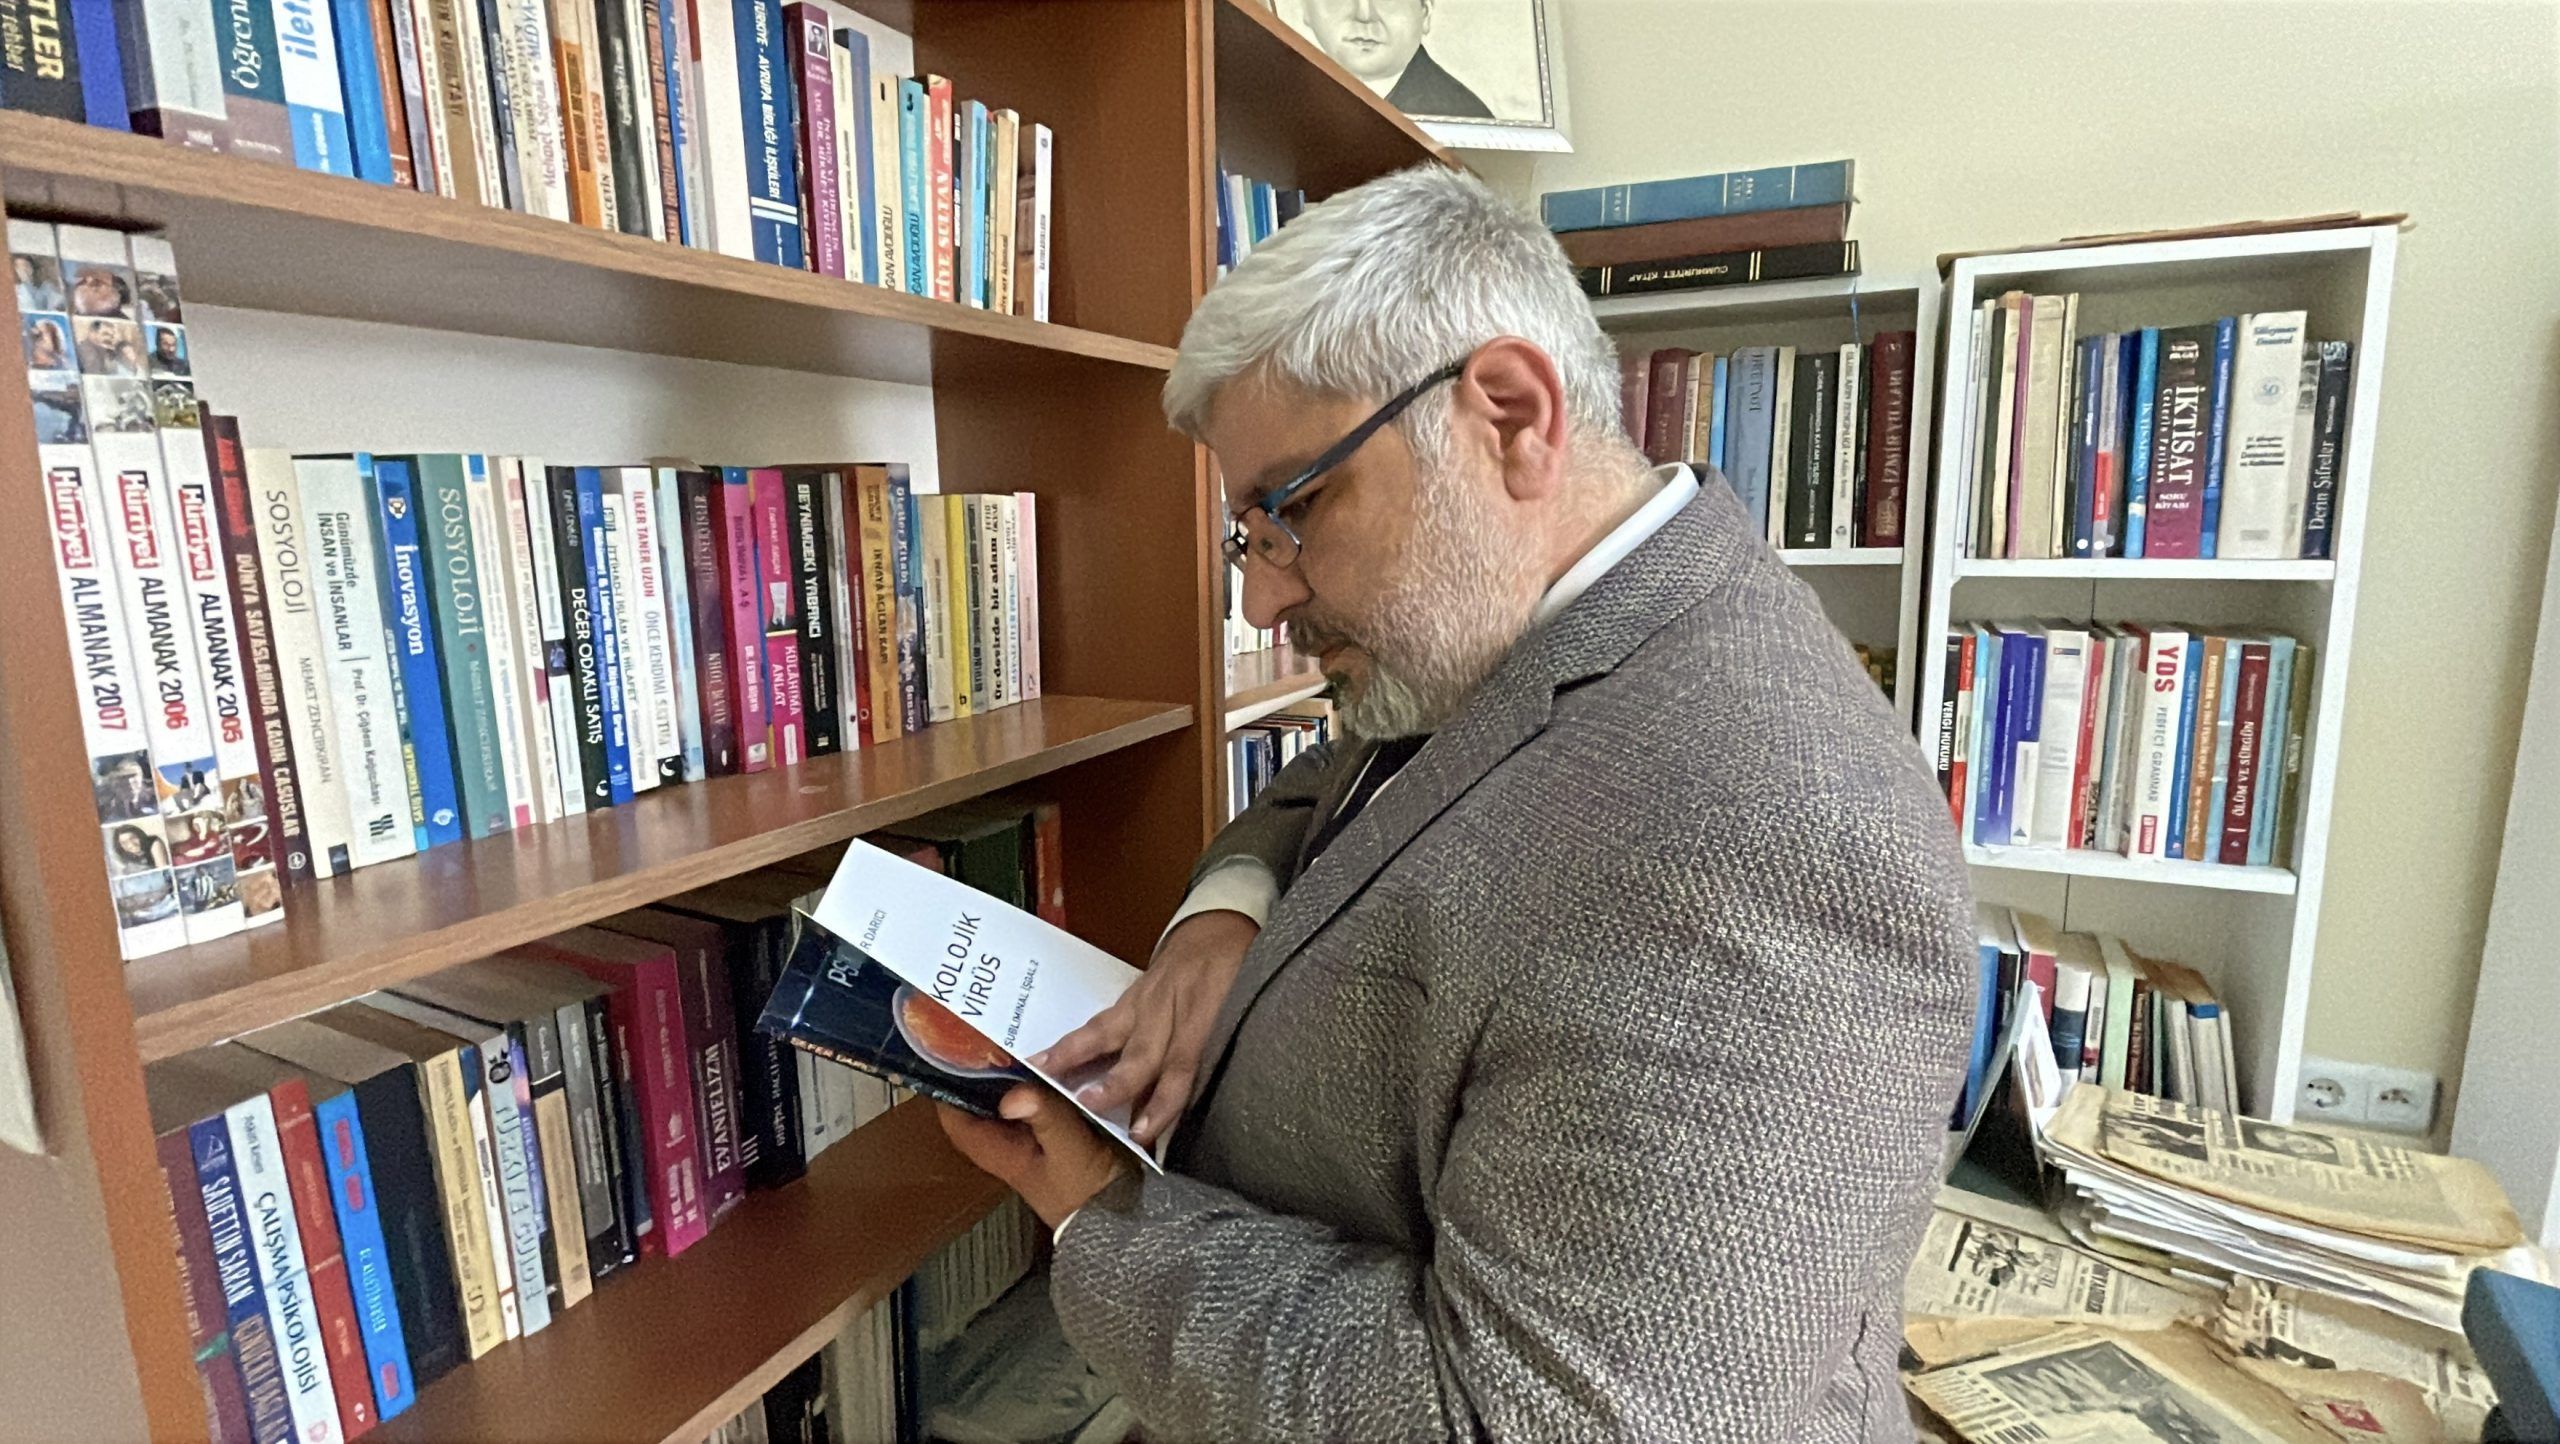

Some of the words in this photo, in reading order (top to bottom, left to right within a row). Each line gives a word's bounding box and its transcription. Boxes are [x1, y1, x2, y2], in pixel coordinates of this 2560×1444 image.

[758, 54, 774, 108] AVRUPA
[1664, 265, 1730, 279] CUMHURİYET
[2168, 386, 2206, 485] İKTİSAT
[48, 467, 93, 569] Hürriyet
[118, 469, 159, 569] Hürriyet
[632, 490, 648, 524] İLKER
[2308, 494, 2325, 530] Derin
[178, 483, 215, 582] Hürriyet
[266, 490, 309, 614] SOSYOLOJİ
[318, 512, 336, 558] İNSAN
[636, 526, 651, 564] TANER
[325, 560, 336, 577] ve
[438, 487, 485, 637] SOSYOLOJİ
[640, 566, 655, 598] UZUN
[328, 579, 354, 650] İNSANLAR
[393, 544, 425, 657] İnovasyon
[570, 587, 593, 638] DEĞER
[990, 587, 999, 609] bir
[71, 576, 118, 681] ALMANAK
[139, 576, 181, 677] ALMANAK
[199, 592, 235, 692] ALMANAK
[352, 669, 365, 693] Prof.
[577, 641, 599, 699] ODAKLI
[772, 663, 787, 708] ANLAT
[2154, 645, 2180, 693] YDS
[93, 682, 128, 732] 2007
[155, 680, 190, 730] 2006
[214, 694, 245, 744] 2005
[584, 702, 604, 745] SATIŞ
[1942, 700, 1954, 729] VERGİ
[1939, 730, 1951, 771] HUKUKU
[2231, 784, 2248, 817] ÖLÜM
[863, 909, 888, 945] DARICI
[960, 953, 1001, 1018] VİRÜS
[704, 1044, 730, 1173] EVANJELİZM
[254, 1191, 293, 1281] ÇALIŞMA
[276, 1280, 321, 1395] PSİKOLOJİSİ
